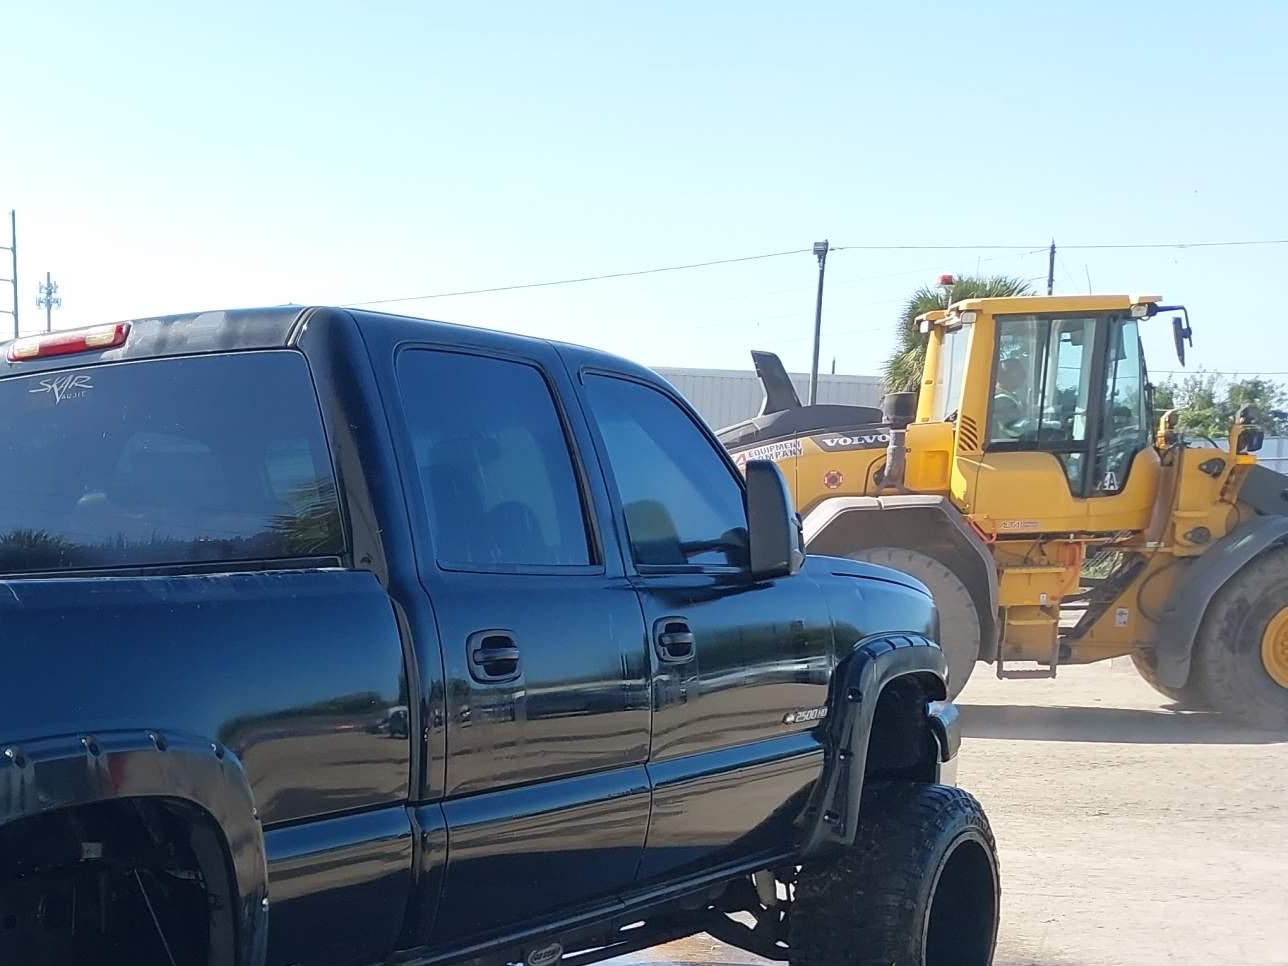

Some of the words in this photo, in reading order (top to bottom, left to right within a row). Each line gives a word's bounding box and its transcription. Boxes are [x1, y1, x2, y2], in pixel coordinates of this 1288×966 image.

[822, 434, 890, 447] VOLVO
[748, 441, 801, 458] EQUIPMENT
[757, 448, 803, 461] OMPANY
